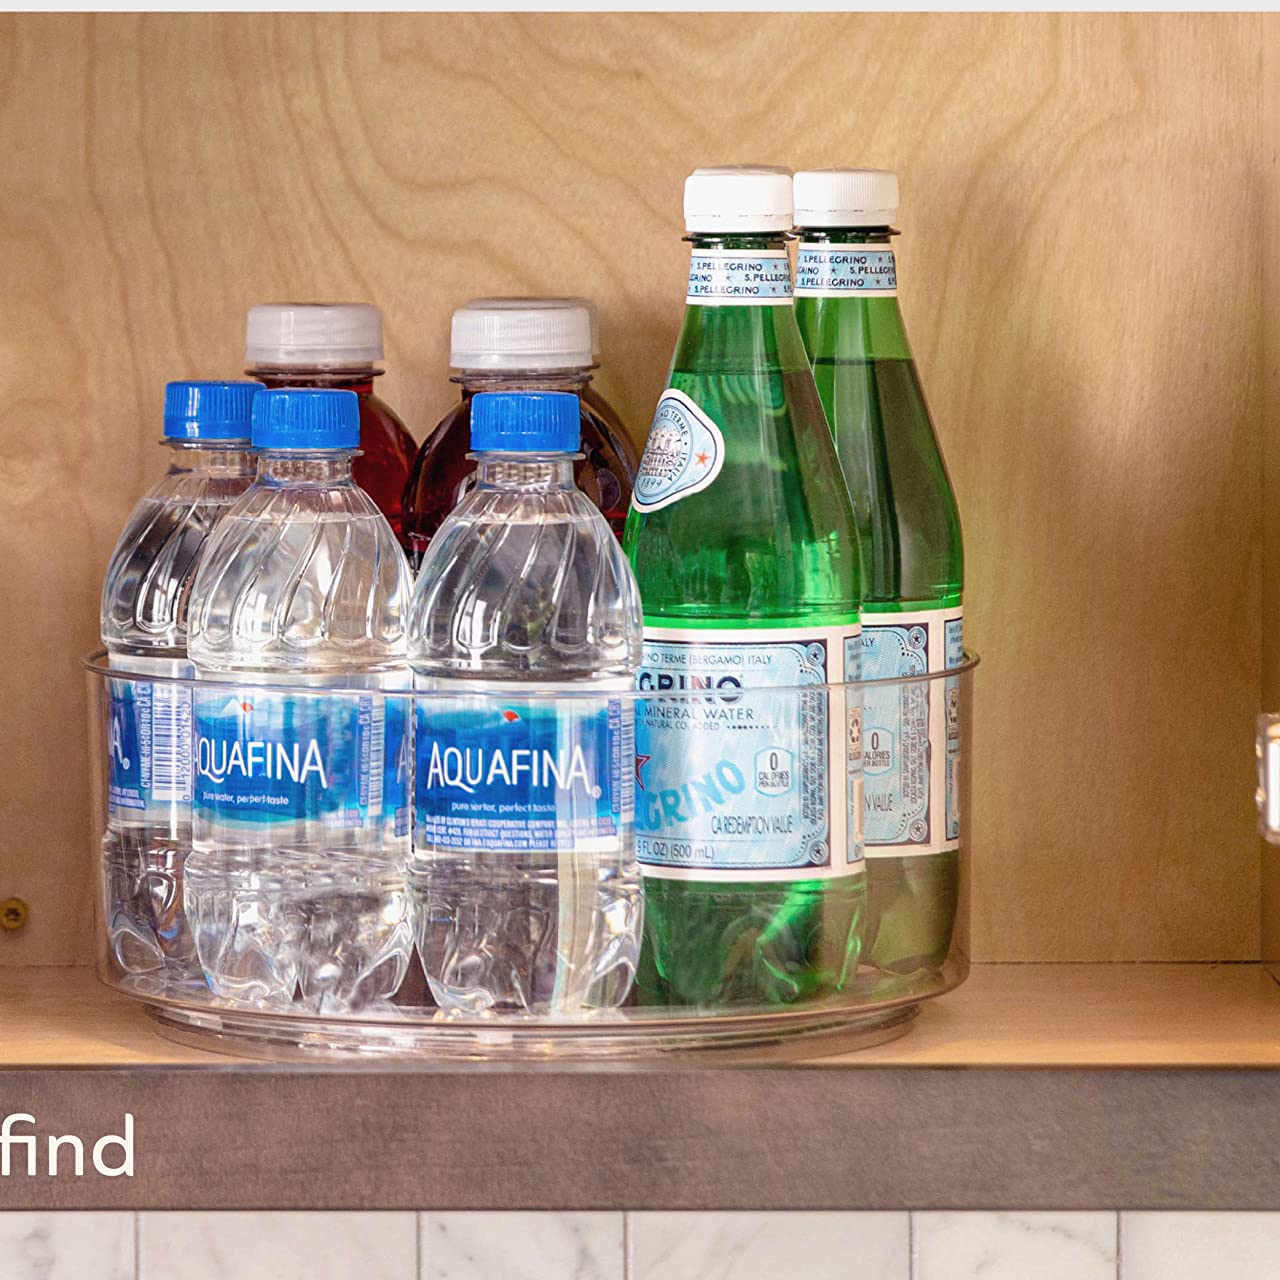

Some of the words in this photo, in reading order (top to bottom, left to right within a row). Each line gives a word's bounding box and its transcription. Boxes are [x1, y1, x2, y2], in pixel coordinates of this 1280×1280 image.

[641, 478, 663, 488] 1899
[660, 654, 686, 664] TERME
[748, 655, 773, 665] ITALY
[704, 708, 754, 720] WATER
[871, 732, 879, 750] 0
[427, 741, 593, 795] AQUAFINA
[770, 752, 778, 770] 0
[267, 795, 289, 805] taste
[499, 802, 531, 812] perfect
[873, 793, 893, 812] VALUE
[771, 815, 793, 834] VALUE
